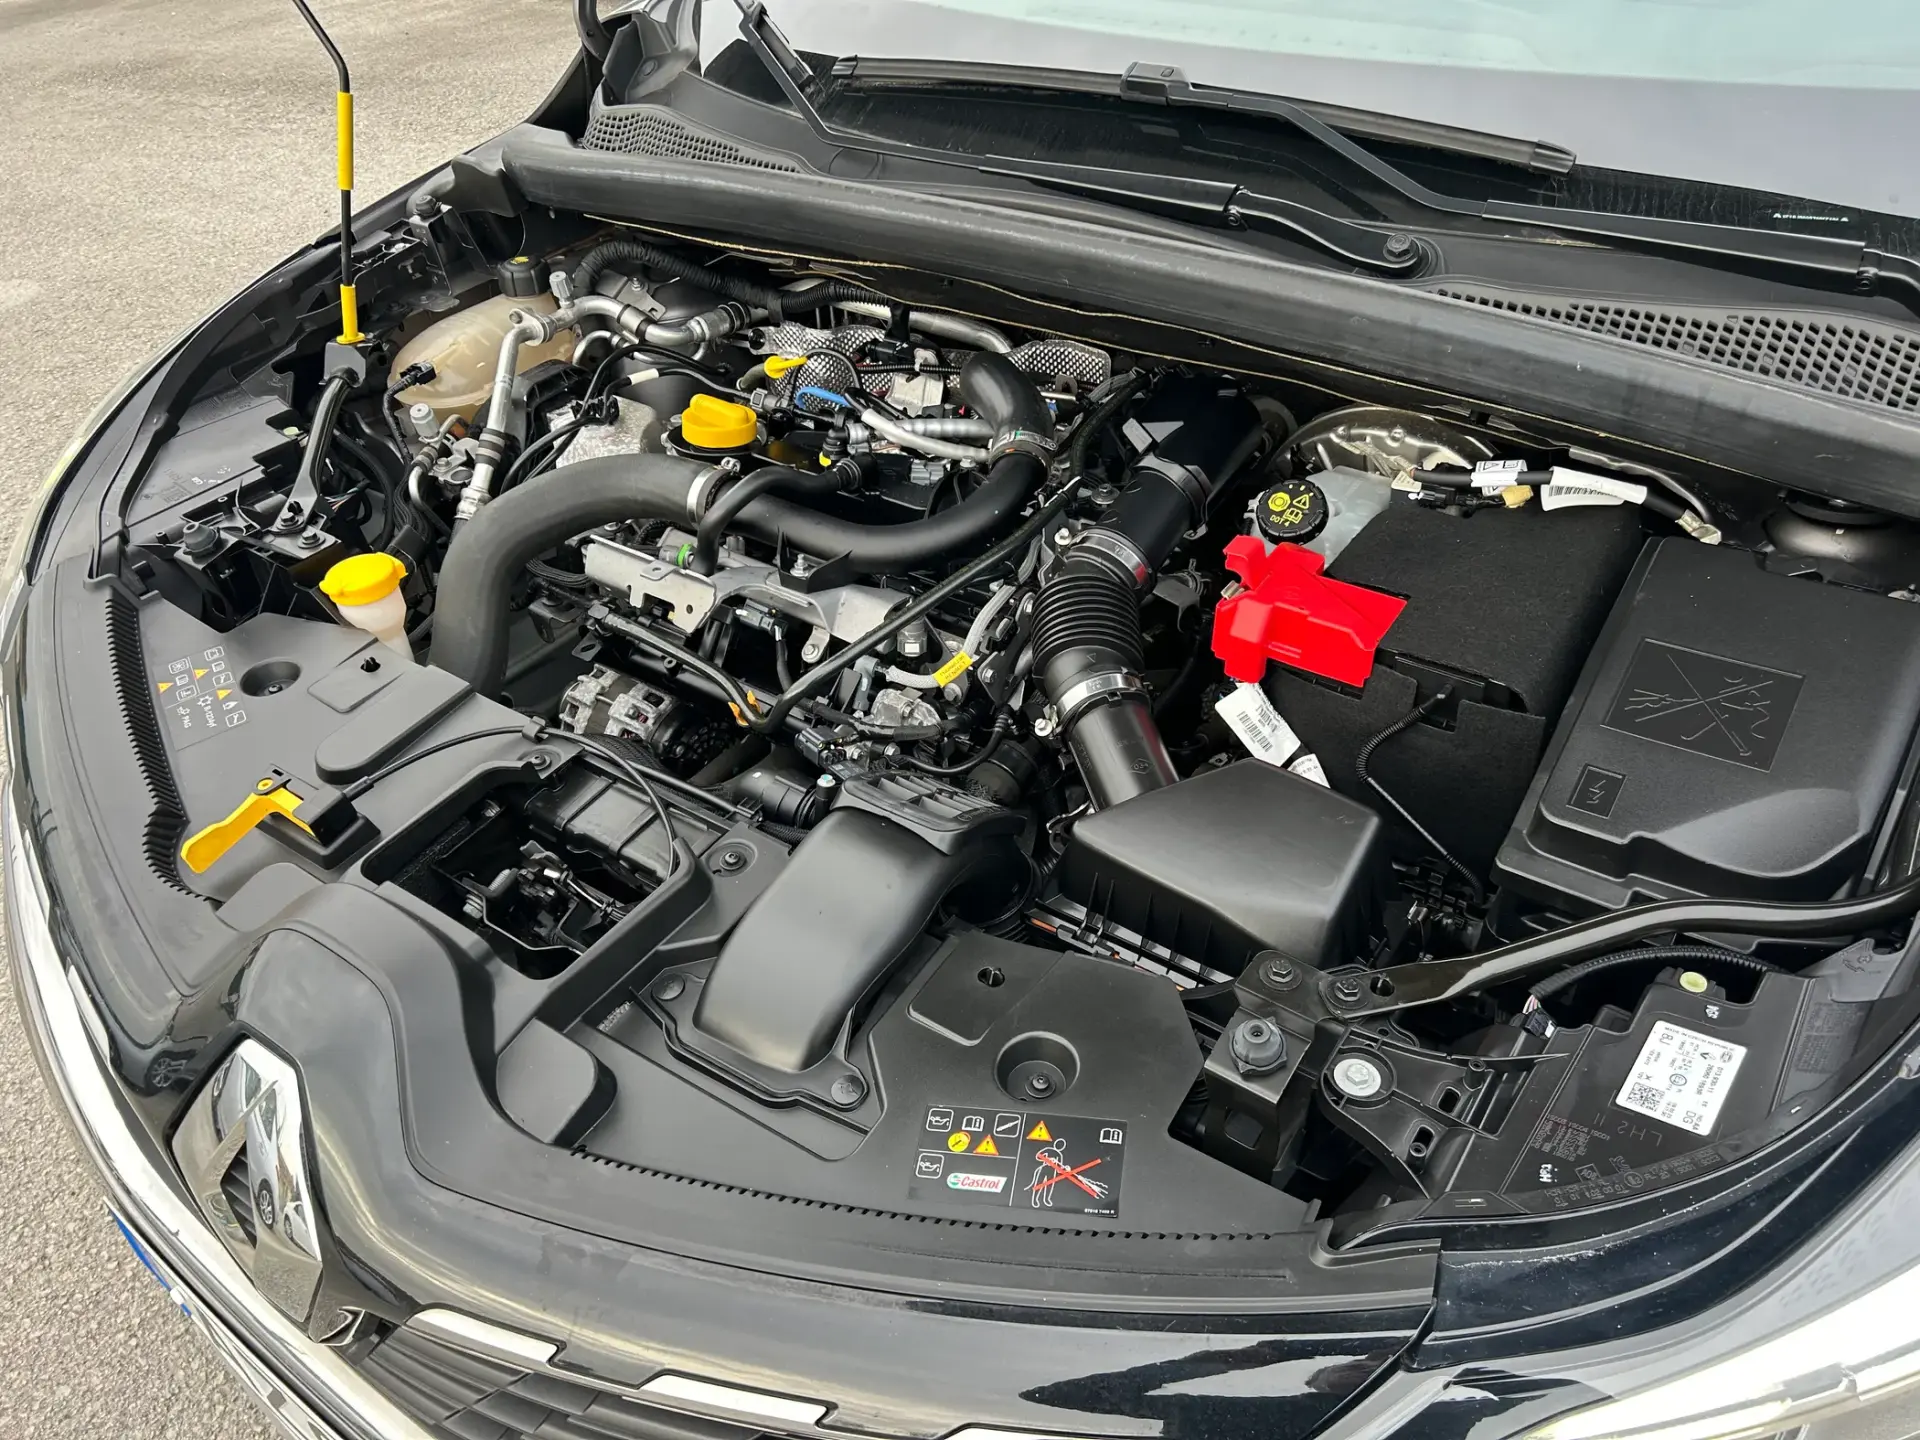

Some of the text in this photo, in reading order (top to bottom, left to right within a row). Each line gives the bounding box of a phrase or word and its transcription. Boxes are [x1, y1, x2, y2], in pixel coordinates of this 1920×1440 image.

[1270, 514, 1285, 524] DOT
[182, 714, 192, 728] PAG
[1682, 1110, 1696, 1124] DG
[960, 1176, 1000, 1189] Castrol
